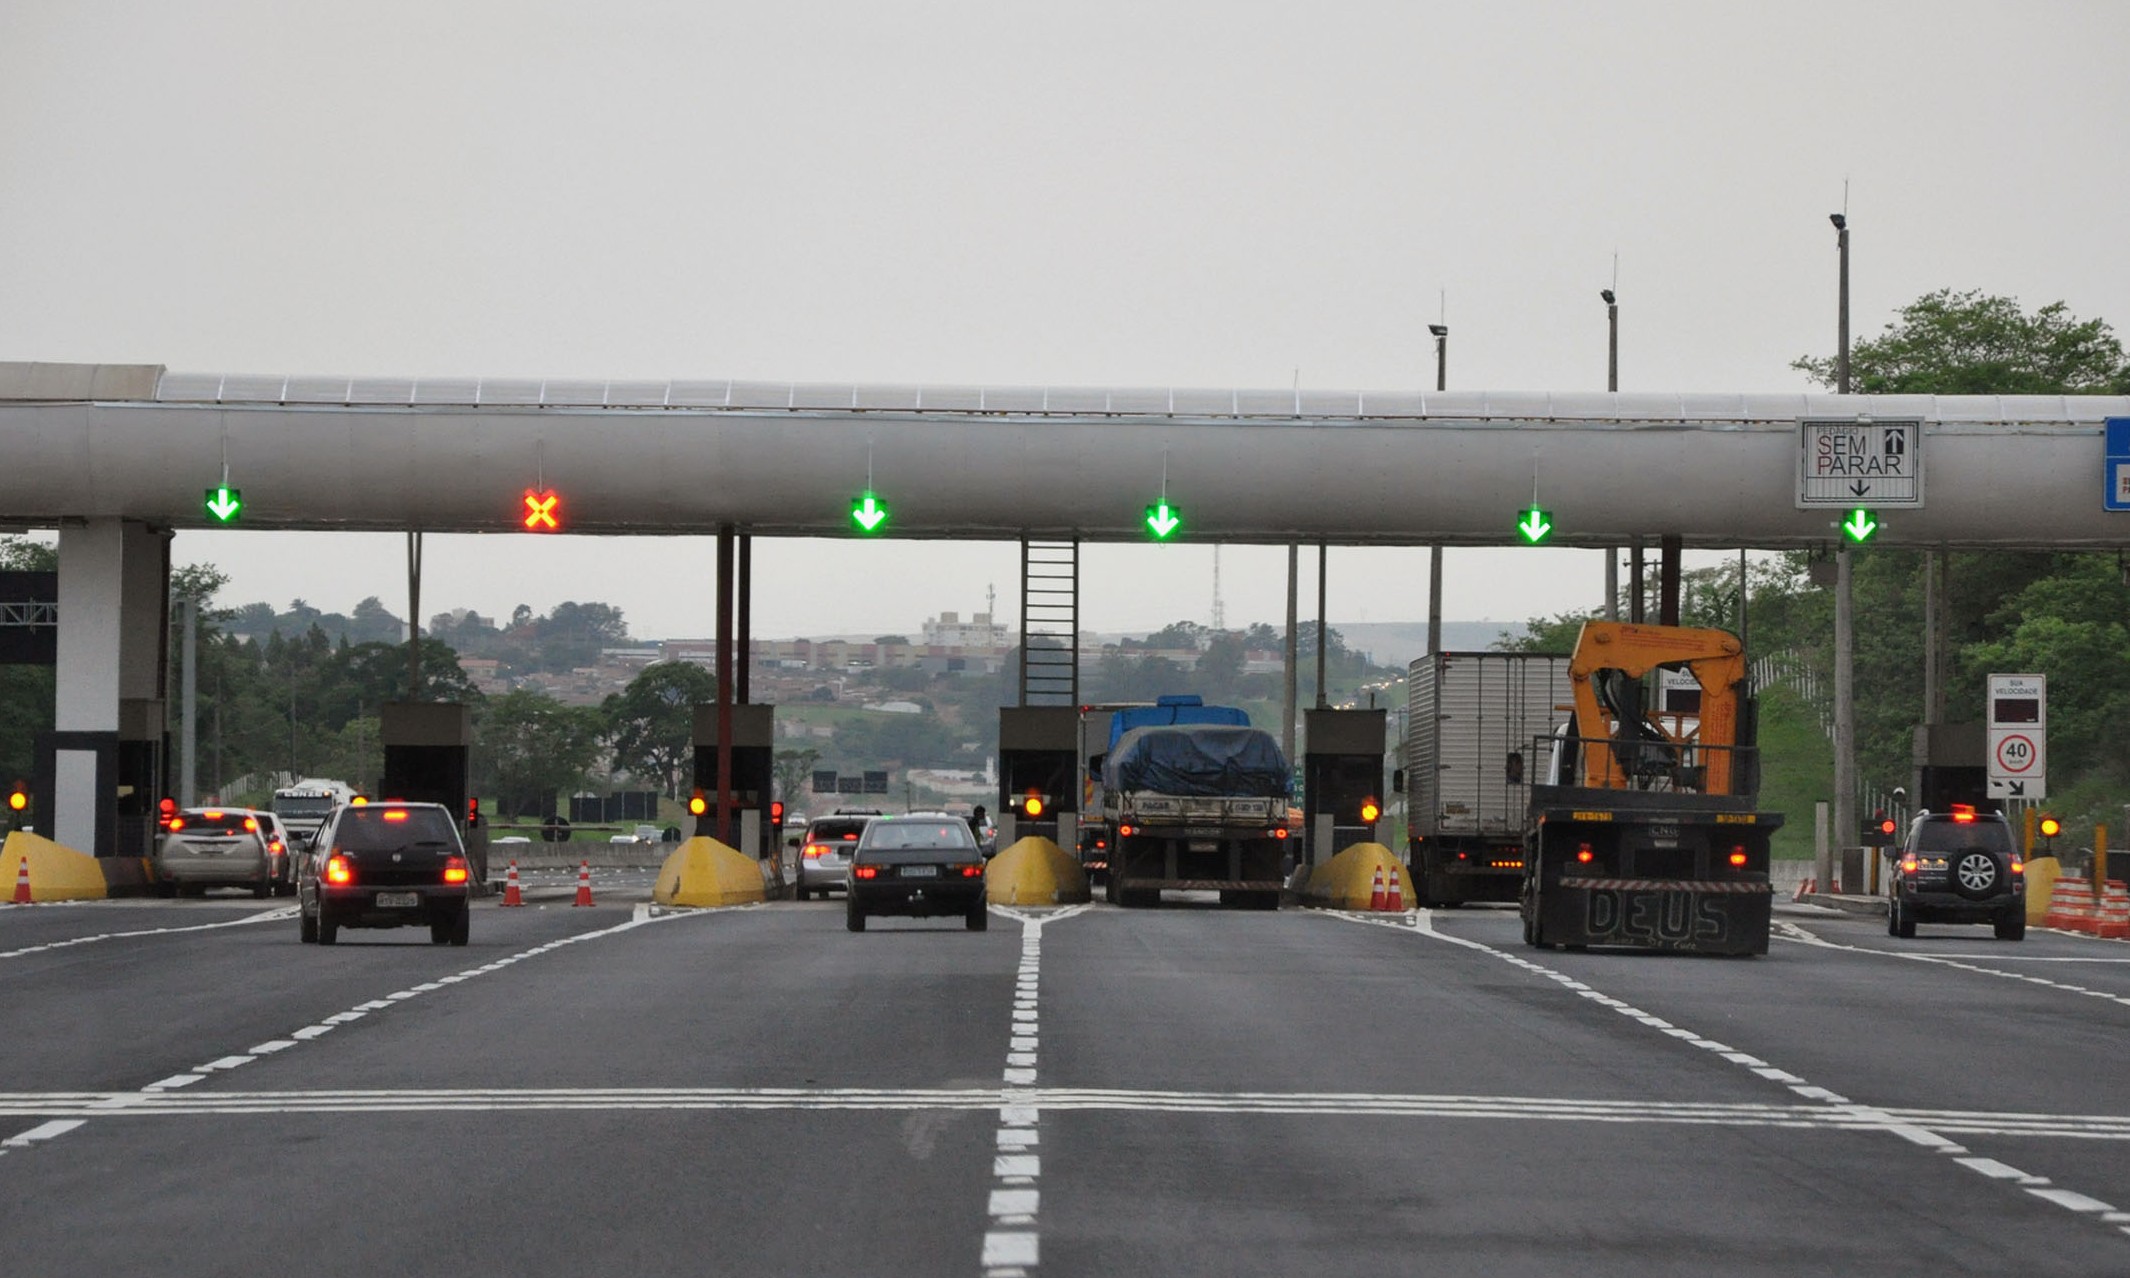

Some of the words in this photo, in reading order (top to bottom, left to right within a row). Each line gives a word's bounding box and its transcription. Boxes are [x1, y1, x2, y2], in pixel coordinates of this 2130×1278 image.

[1818, 435, 1866, 455] SEM
[1818, 455, 1901, 475] PARAR
[2006, 743, 2027, 758] 40
[1587, 889, 1728, 942] DEUS
